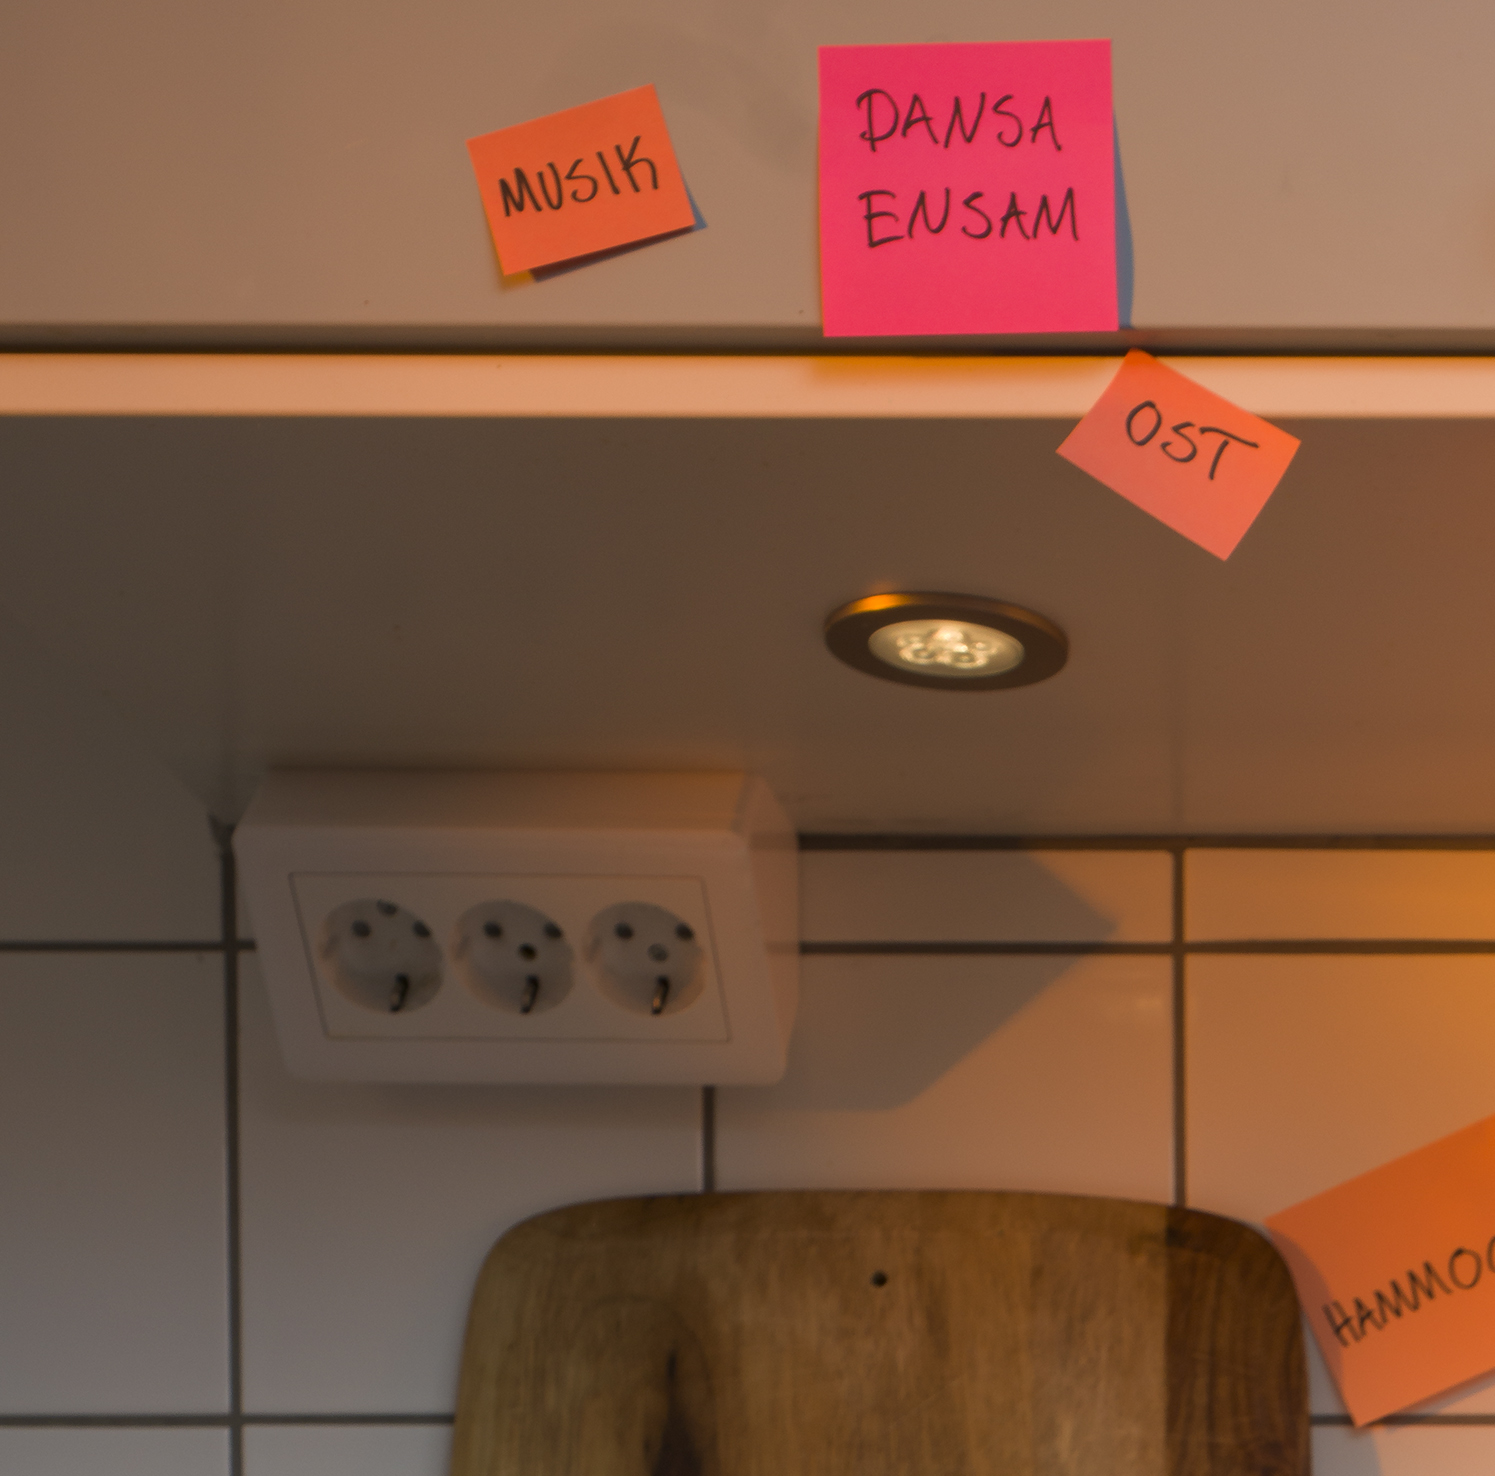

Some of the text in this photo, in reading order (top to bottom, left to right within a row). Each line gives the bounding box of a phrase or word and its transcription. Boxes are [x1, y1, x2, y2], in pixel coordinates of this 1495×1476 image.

[856, 88, 1062, 152] DANSA
[499, 136, 659, 217] MUSIK
[858, 187, 1078, 248] ENSAM
[1125, 400, 1259, 480] OST
